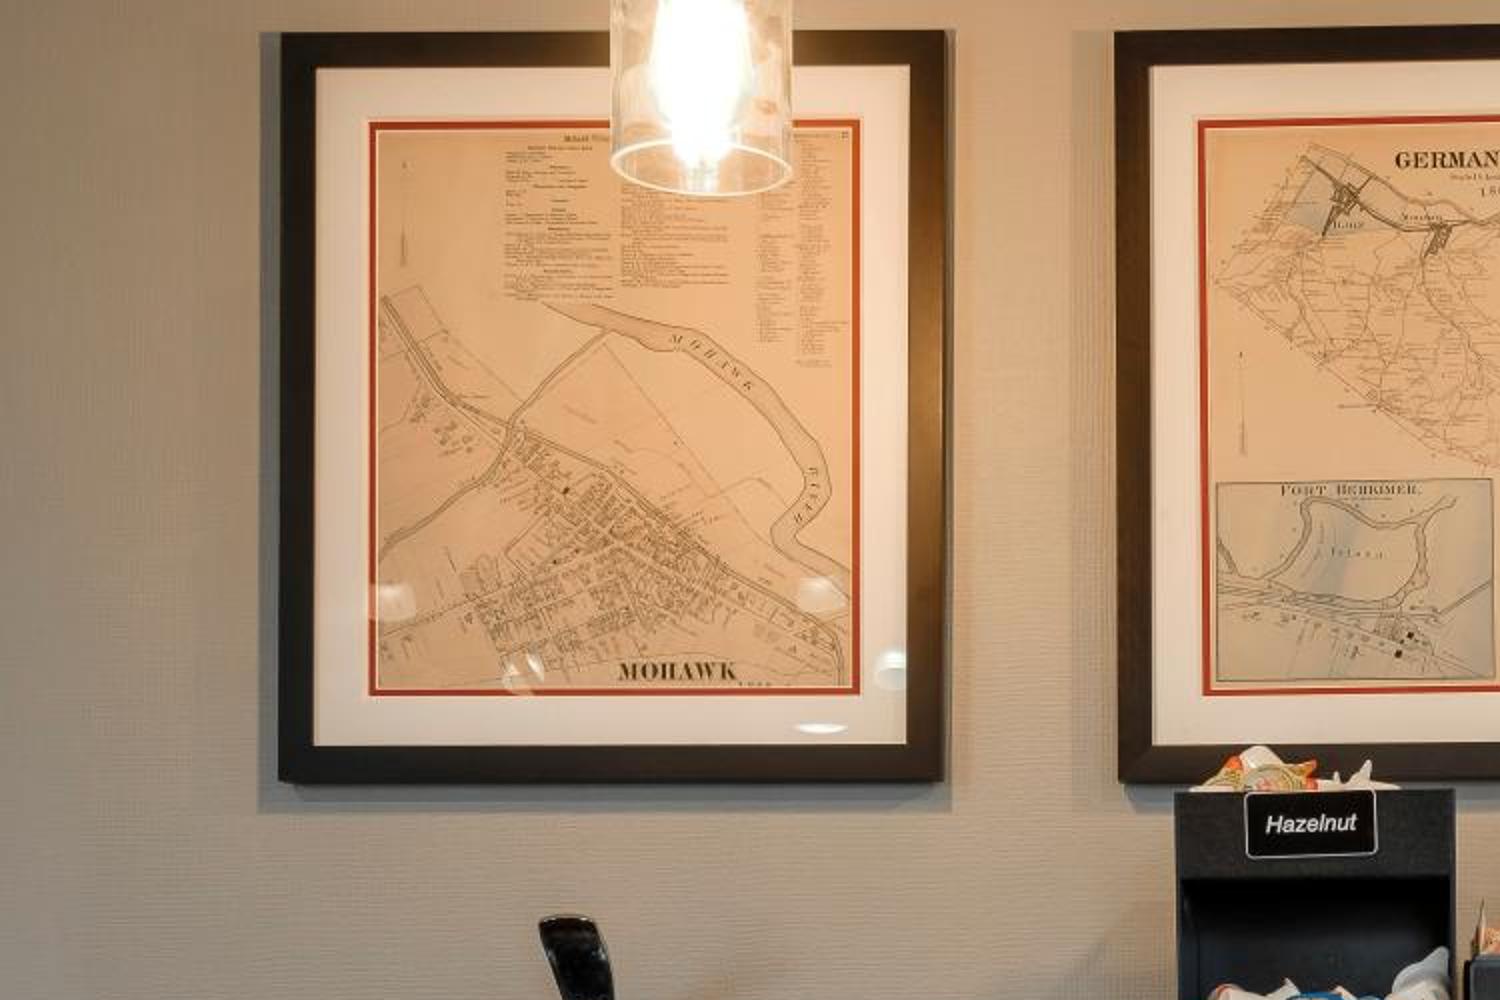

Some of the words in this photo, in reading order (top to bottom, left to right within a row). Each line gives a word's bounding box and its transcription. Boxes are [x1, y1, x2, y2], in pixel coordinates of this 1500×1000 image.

[1395, 151, 1499, 168] GERMAN
[618, 661, 736, 681] MOHAWK
[1265, 813, 1358, 834] Hazelnut
